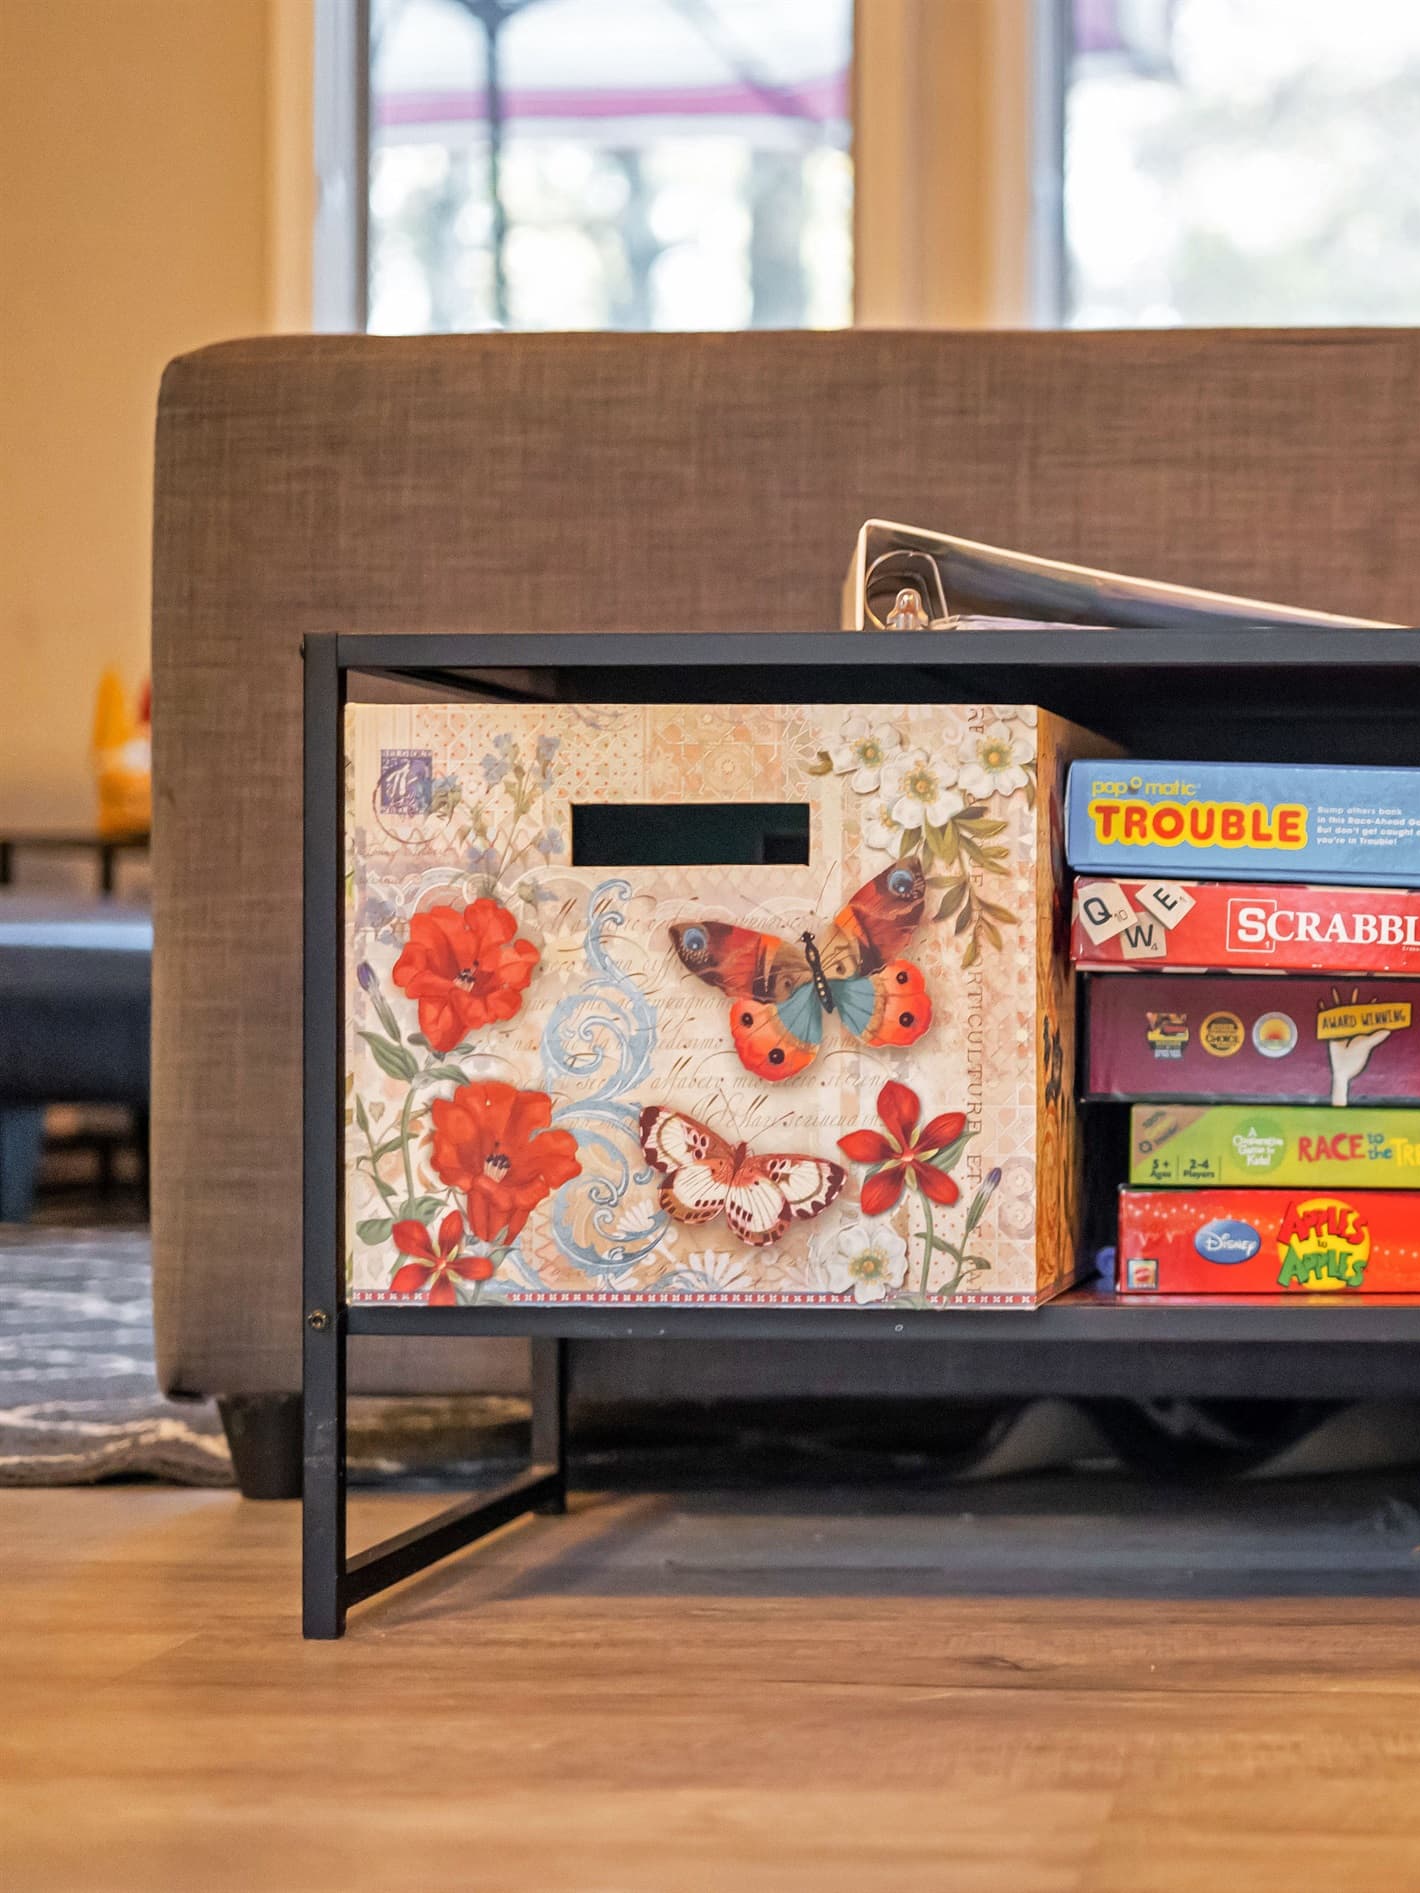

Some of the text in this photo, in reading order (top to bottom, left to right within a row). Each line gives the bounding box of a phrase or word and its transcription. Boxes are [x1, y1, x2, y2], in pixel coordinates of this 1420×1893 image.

[1145, 778, 1196, 797] matic
[1317, 806, 1402, 816] Bump others back
[1092, 803, 1304, 845] TROUBLE
[1316, 825, 1332, 834] But
[1335, 825, 1359, 834] don't
[1362, 827, 1378, 837] get
[1380, 828, 1413, 837] caught
[1317, 816, 1326, 824] in
[1328, 816, 1345, 825] this
[1347, 817, 1405, 827] Race-Ahead
[1316, 836, 1345, 845] you're
[1360, 837, 1397, 846] Trouble!
[1152, 887, 1179, 911] E
[1083, 897, 1112, 925] Q
[1124, 924, 1154, 948] W
[967, 905, 983, 1133] ORTICULTURE
[1322, 1009, 1406, 1030] AWARD WINNING
[1248, 1126, 1258, 1137] A
[1367, 1132, 1385, 1144] to
[1298, 1133, 1366, 1162] RACE
[1367, 1145, 1393, 1160] the
[966, 1154, 982, 1184] ET
[1152, 1159, 1160, 1169] 5
[1189, 1159, 1210, 1169] 2-4
[1150, 1168, 1172, 1180] Ages
[1183, 1169, 1215, 1179] Players
[1278, 1200, 1369, 1246] APPLES
[1205, 1231, 1257, 1257] Disney
[1276, 1244, 1369, 1288] APPLES
